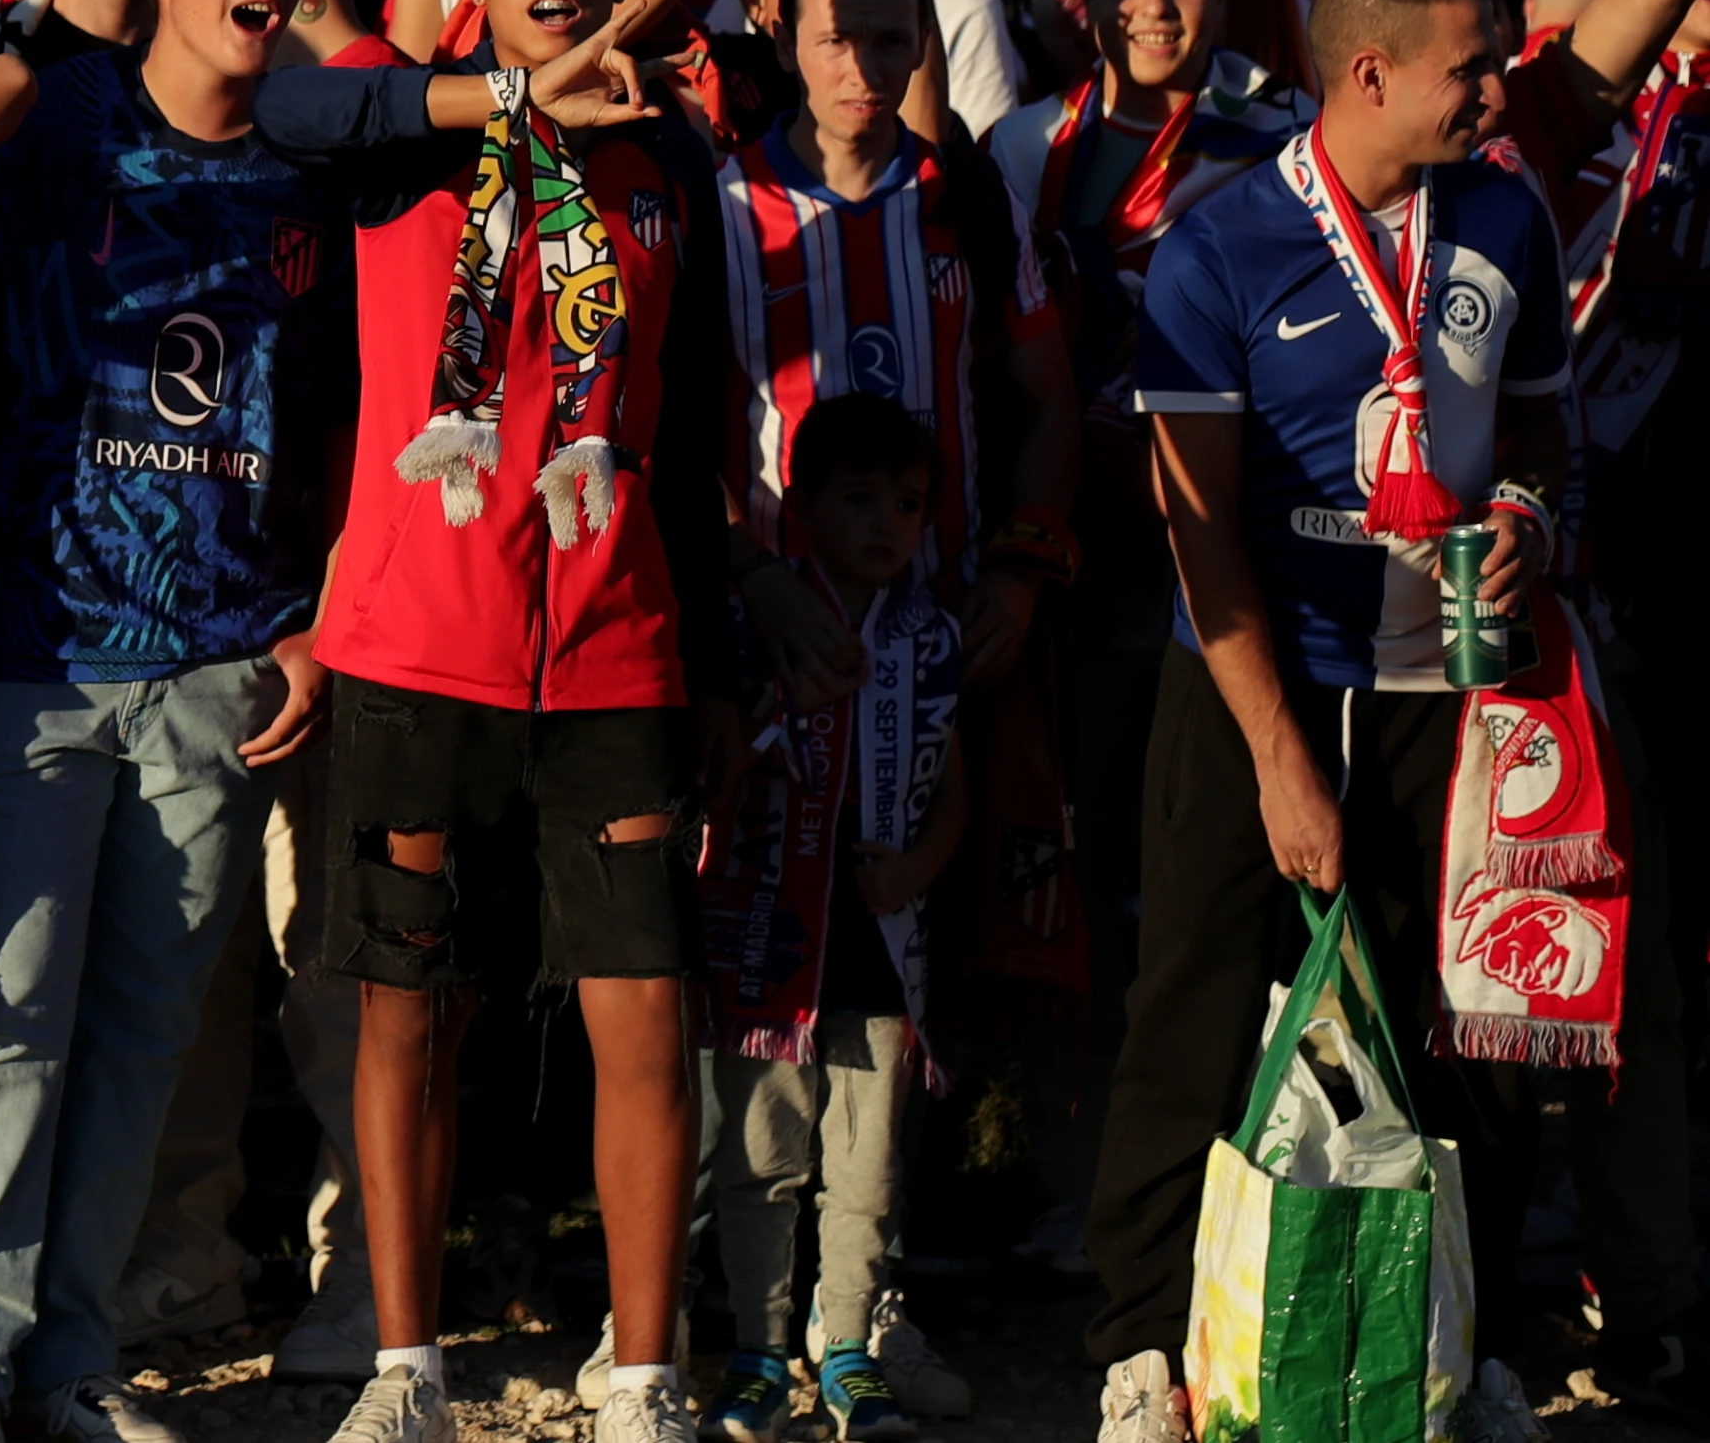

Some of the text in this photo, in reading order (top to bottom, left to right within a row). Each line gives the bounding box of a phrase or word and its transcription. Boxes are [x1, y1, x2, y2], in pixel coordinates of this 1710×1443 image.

[95, 437, 261, 483] RIYADH AIR
[1300, 509, 1401, 542] RIYA
[873, 659, 900, 845] 29 SEPTIEMBRE
